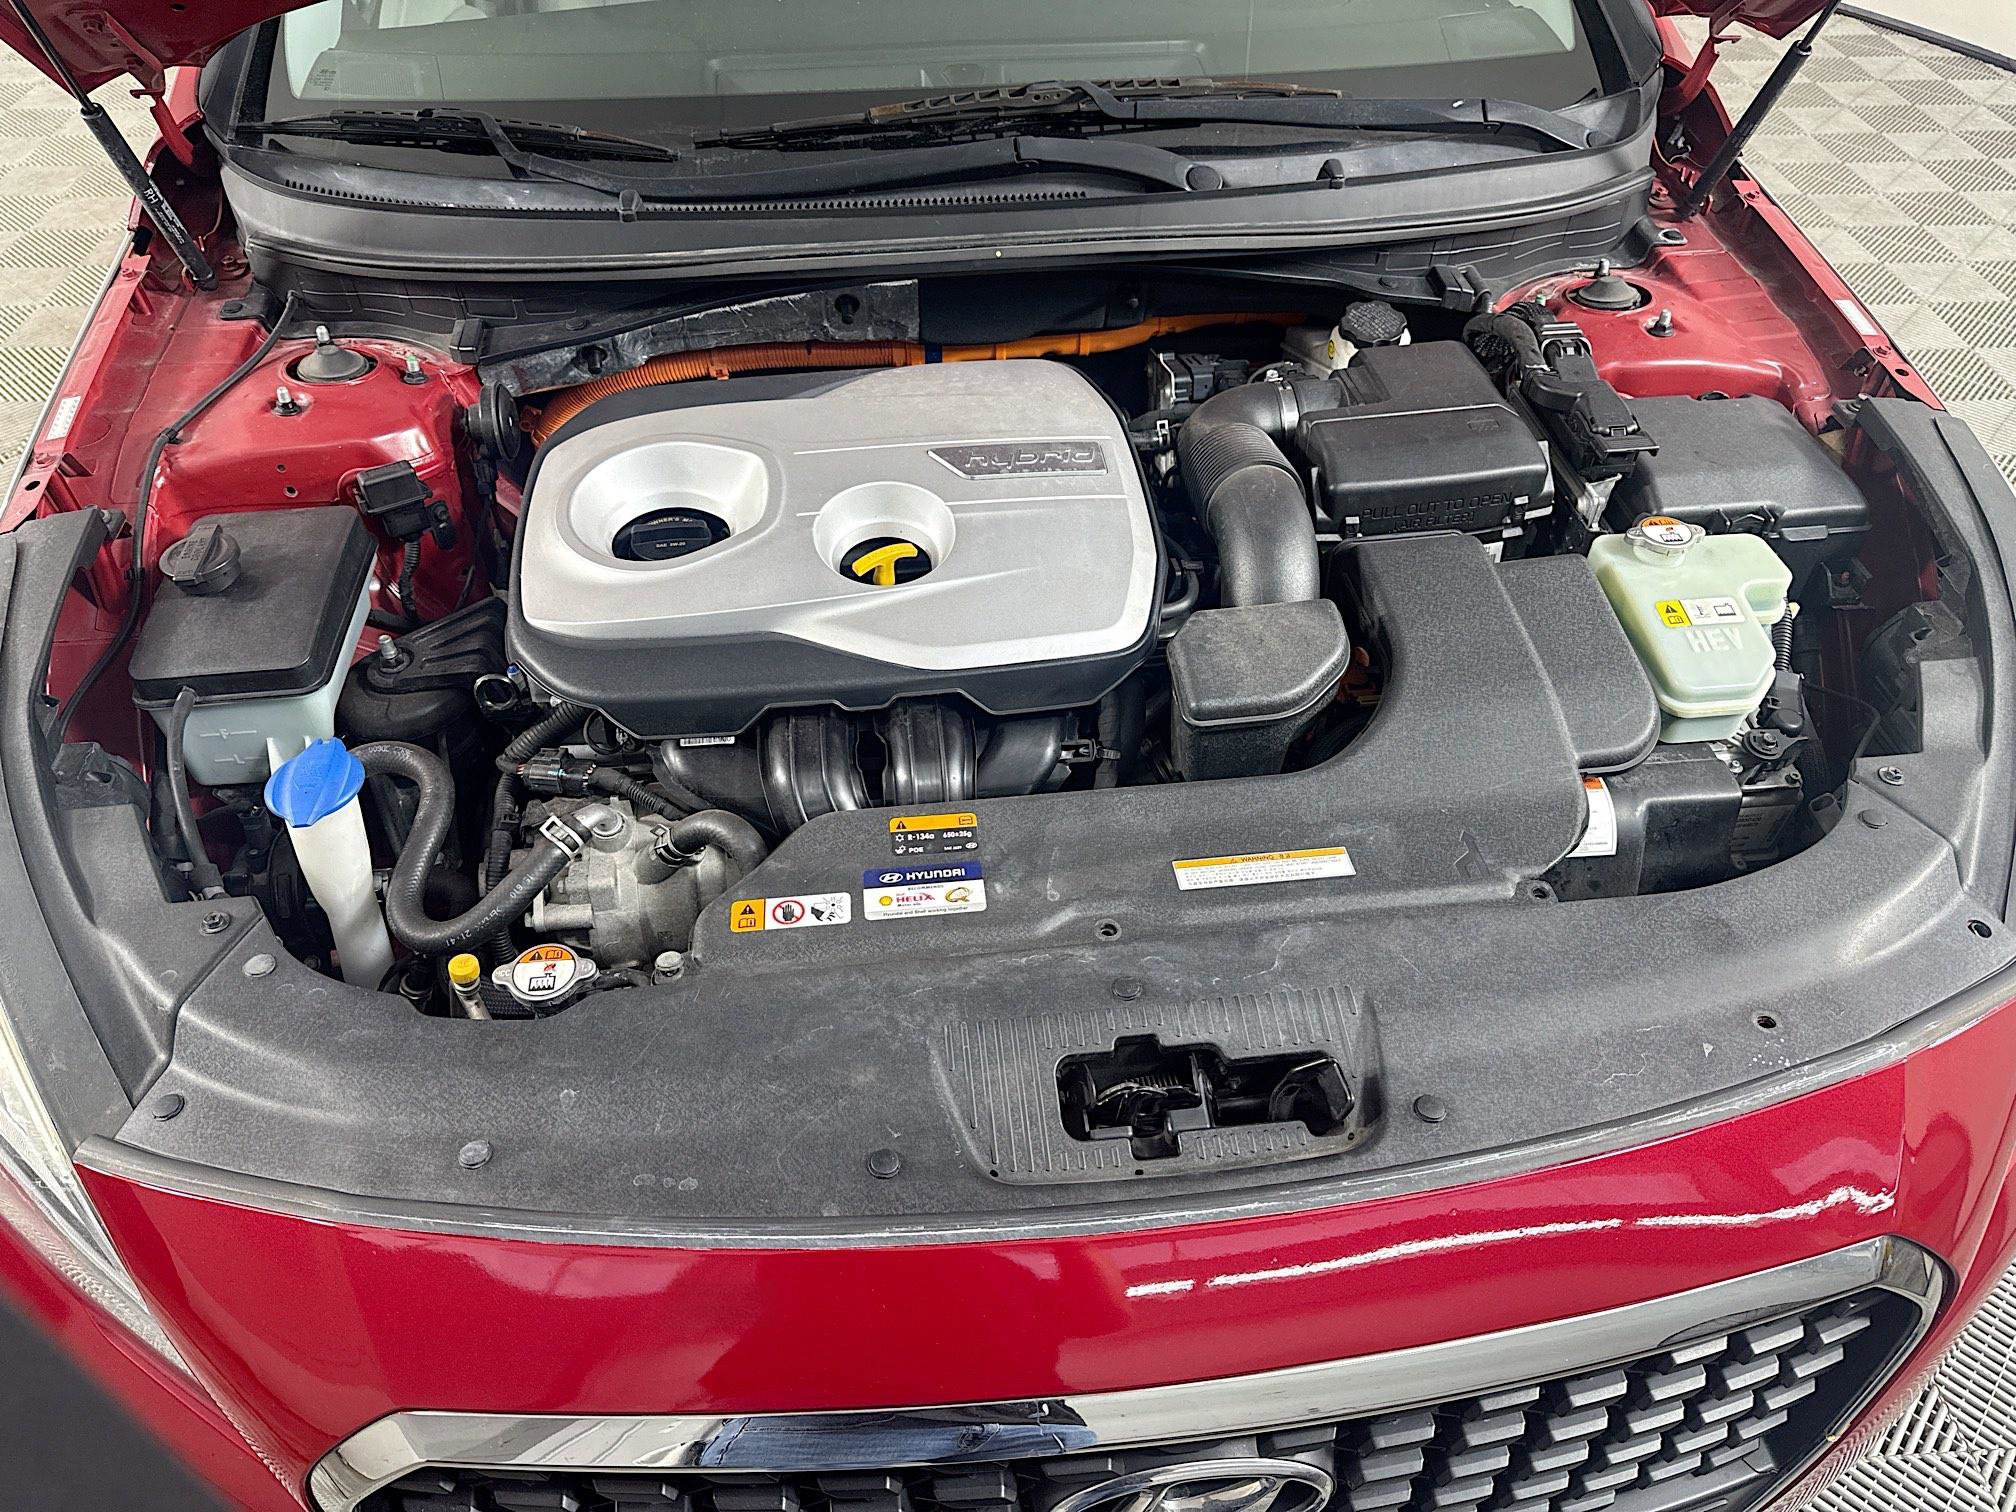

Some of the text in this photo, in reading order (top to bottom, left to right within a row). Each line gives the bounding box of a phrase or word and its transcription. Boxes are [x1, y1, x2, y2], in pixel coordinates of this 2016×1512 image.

[144, 188, 159, 204] RH
[965, 446, 1095, 469] hybrid
[1362, 492, 1512, 519] PULL OUT TO OPEN
[1684, 626, 1744, 653] HEV
[908, 833, 935, 841] R-134a
[1240, 854, 1275, 863] WARNING
[906, 868, 965, 881] HYUNDAI
[896, 892, 935, 903] HELIX
